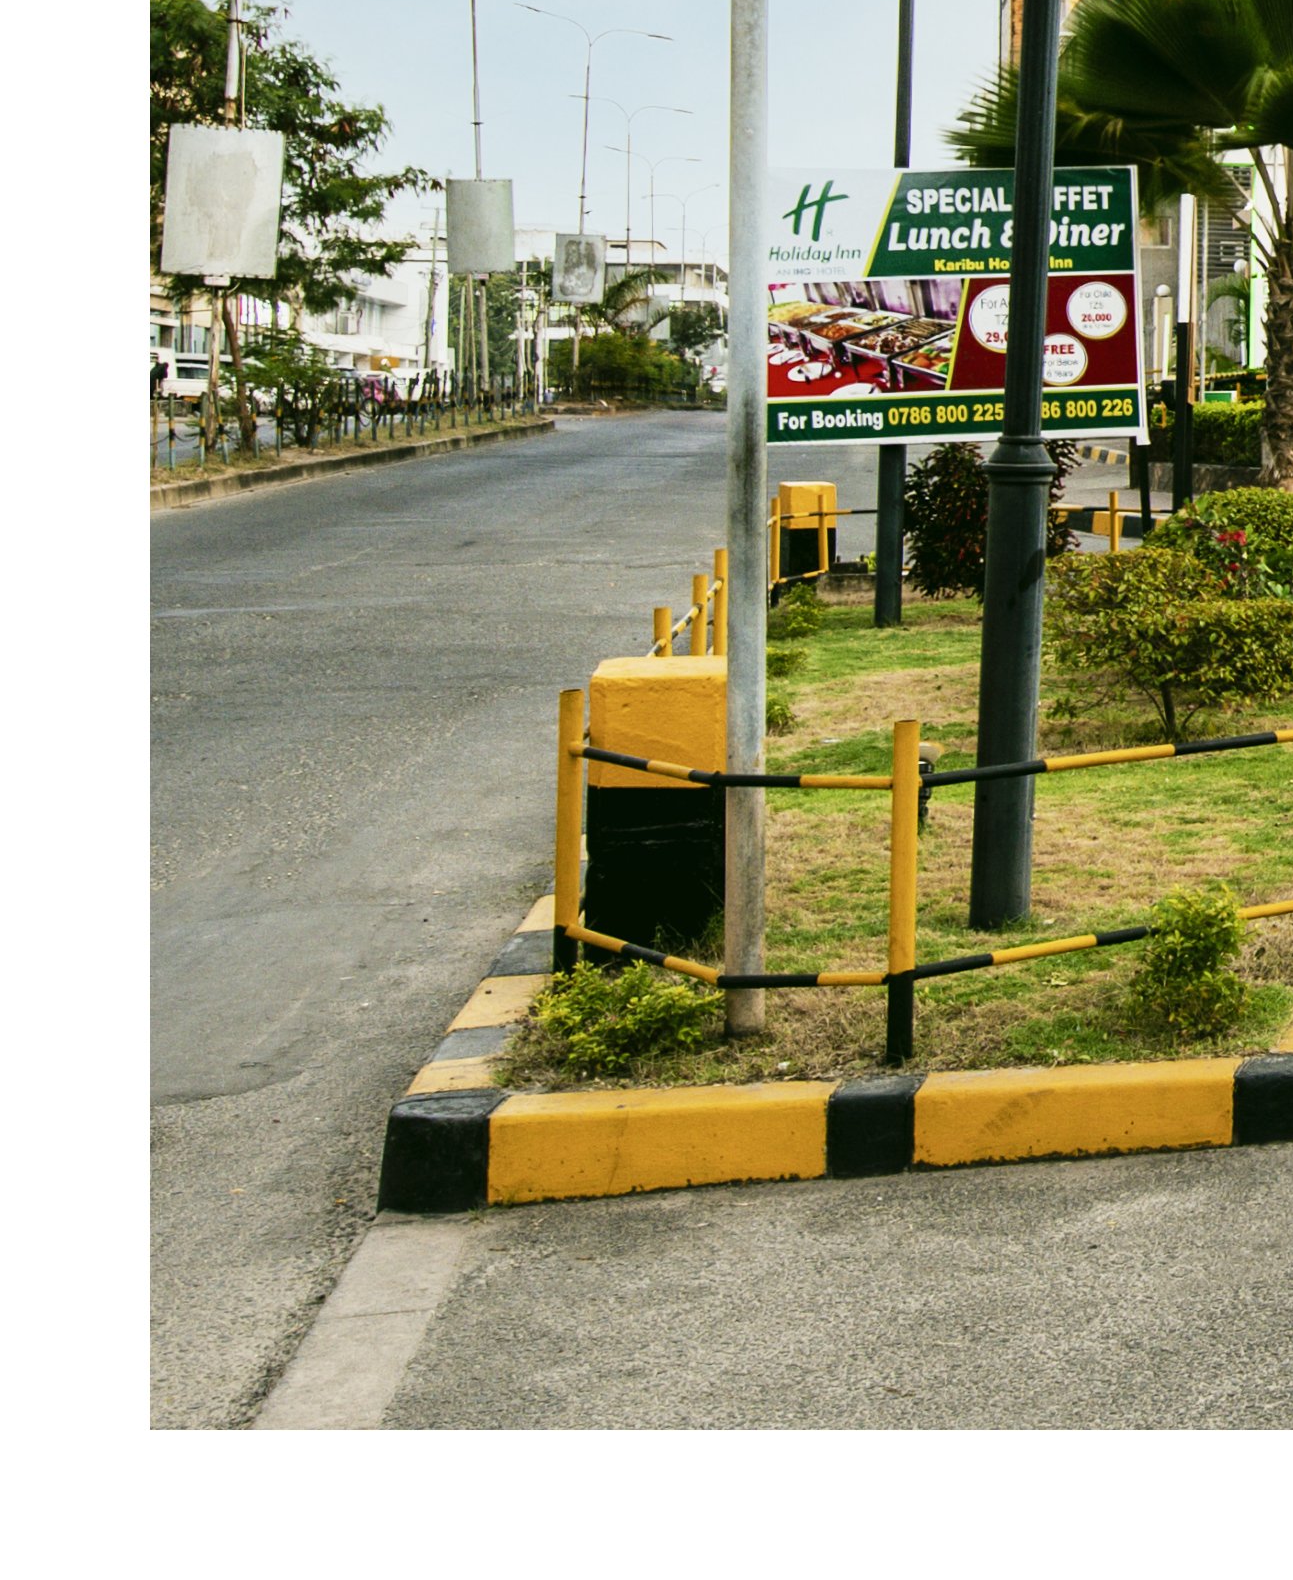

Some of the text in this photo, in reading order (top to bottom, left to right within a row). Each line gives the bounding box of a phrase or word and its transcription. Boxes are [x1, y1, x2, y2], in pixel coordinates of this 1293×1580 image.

[906, 185, 1113, 214] SPECIAL FFET
[888, 217, 991, 251] Lunch
[769, 244, 861, 263] Holiday Inn
[816, 266, 847, 275] HOTEL
[934, 257, 985, 271] Karibu
[1050, 256, 1073, 269] Inn
[1043, 344, 1075, 355] FREE
[778, 411, 808, 431] For
[812, 408, 884, 430] Booking
[888, 407, 931, 425] 0786
[936, 405, 968, 423] 800
[973, 404, 1004, 422] 225
[1066, 399, 1097, 417] 800
[1101, 398, 1134, 417] 226
